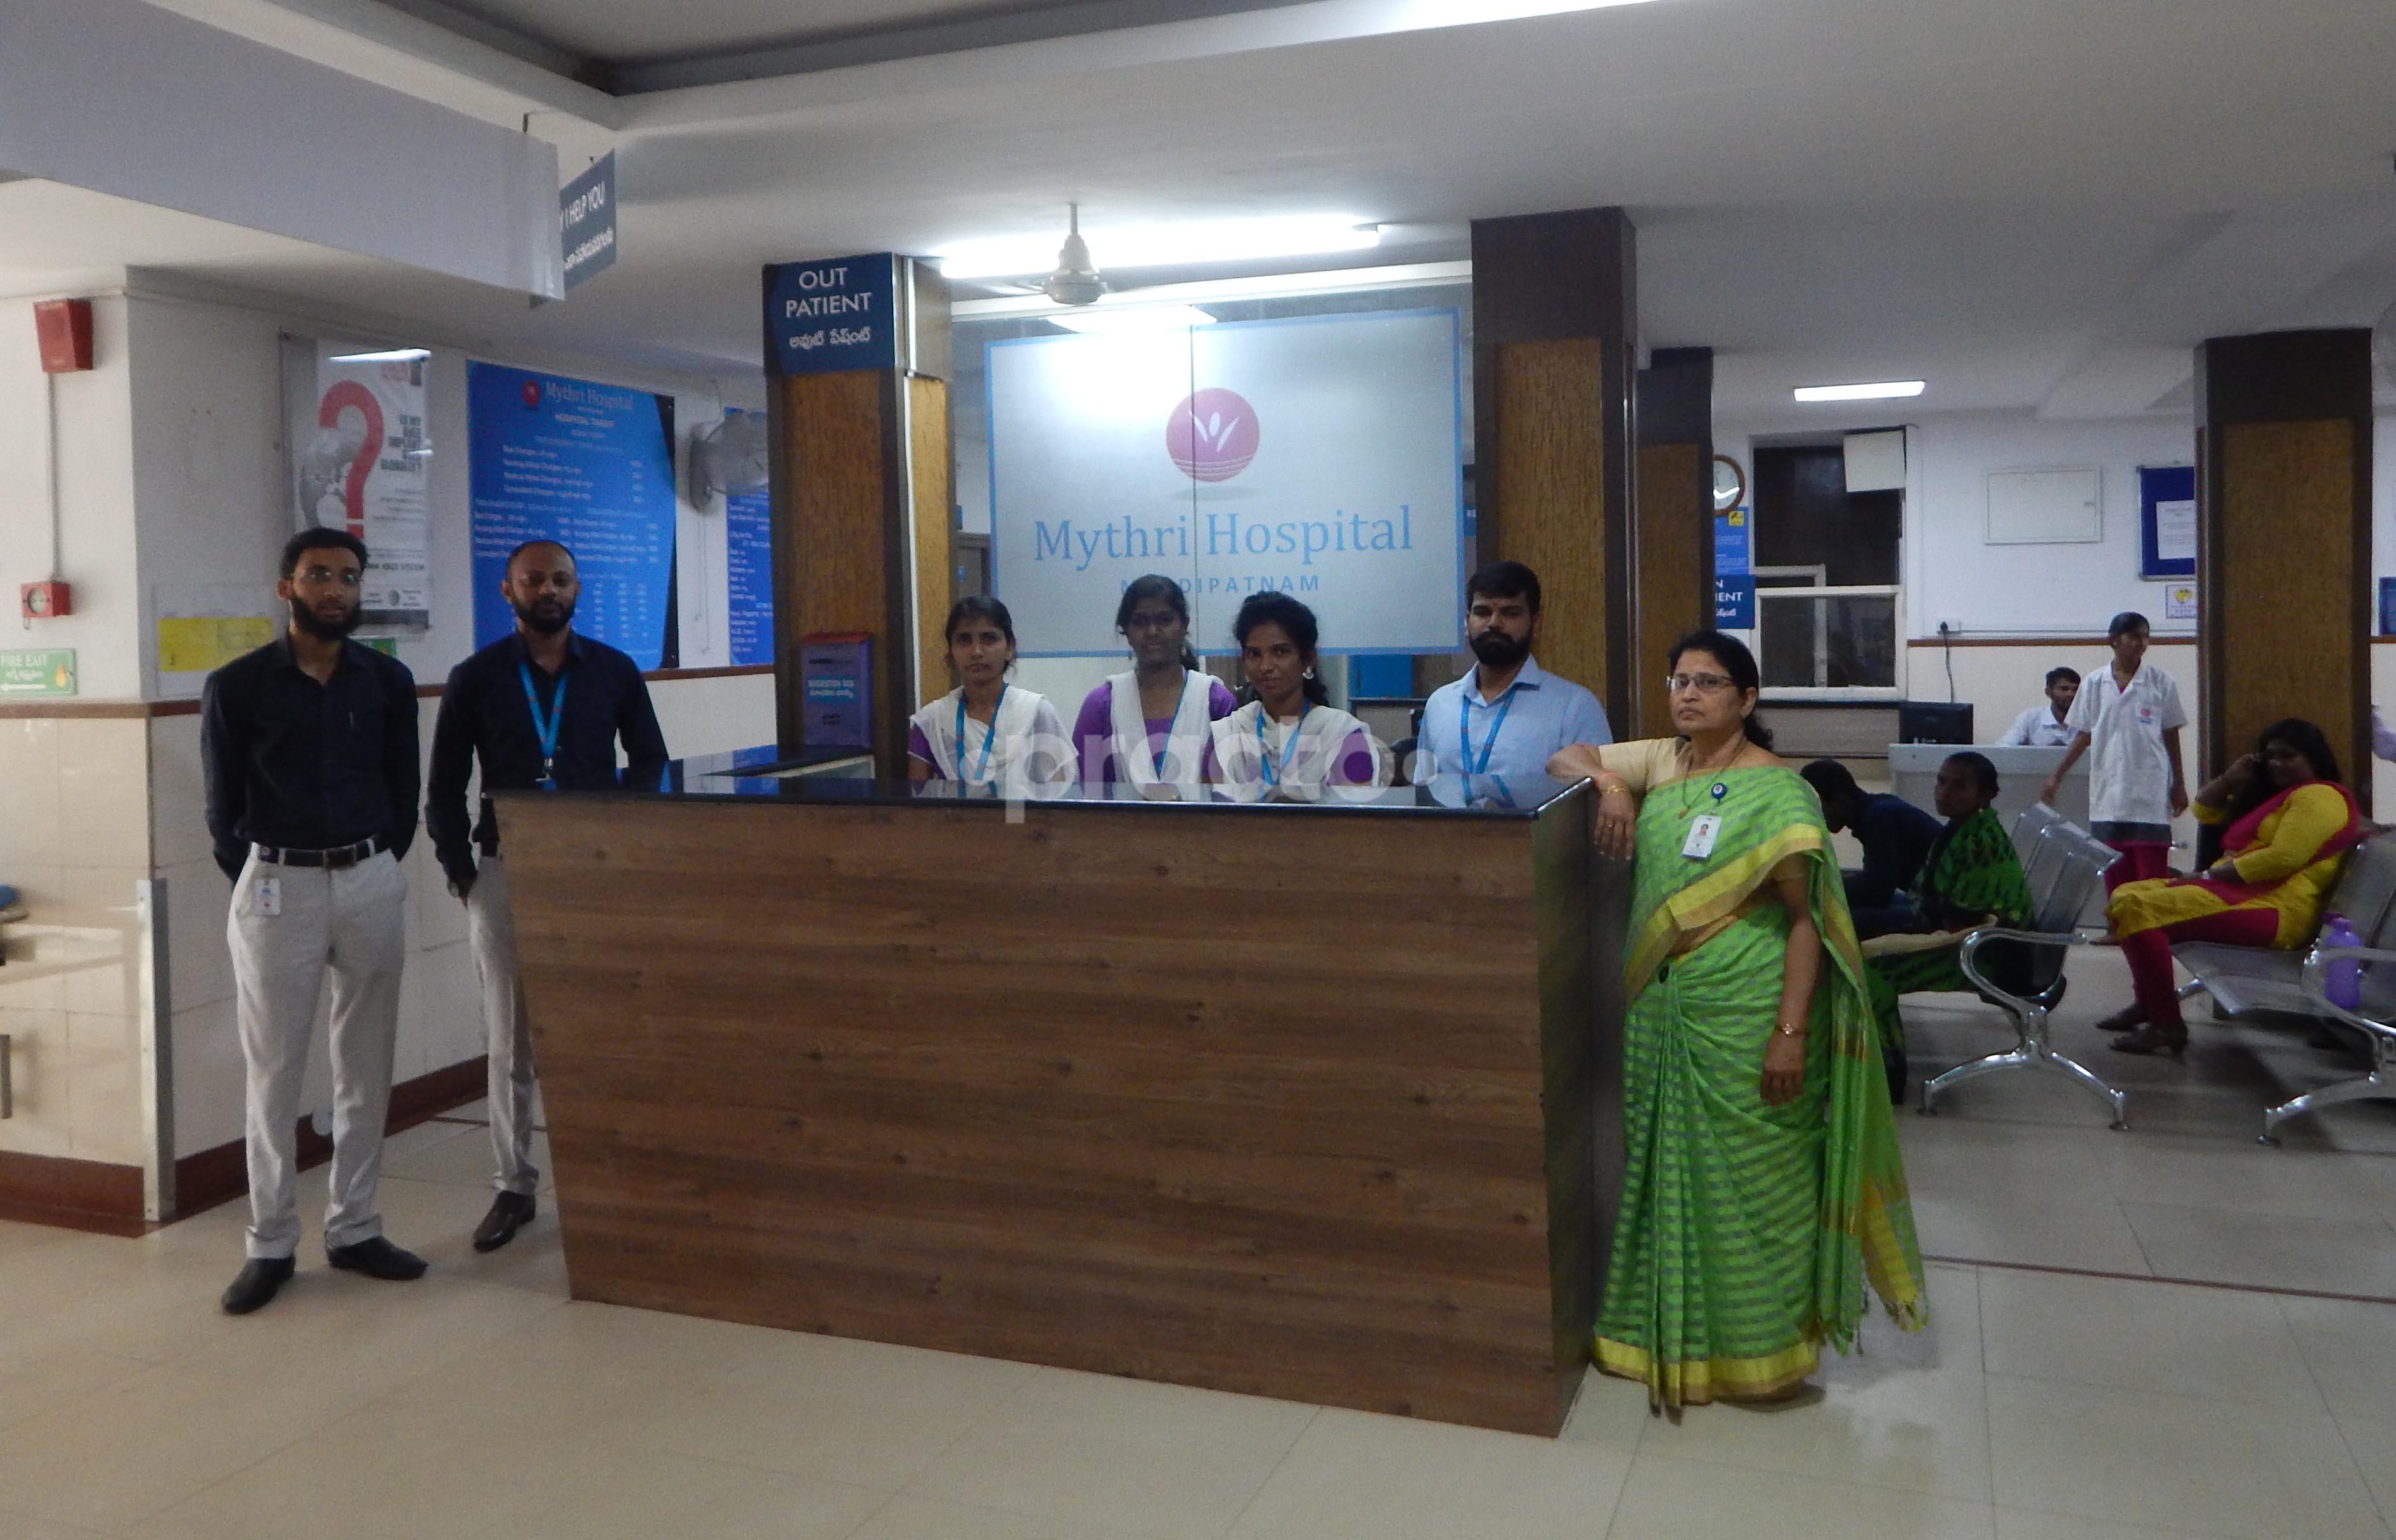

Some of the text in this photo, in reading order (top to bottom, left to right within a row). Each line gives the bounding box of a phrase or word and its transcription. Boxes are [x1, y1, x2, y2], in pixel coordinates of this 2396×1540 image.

[569, 194, 587, 225] HELP
[587, 180, 606, 212] YOU
[799, 267, 848, 290] OUT
[785, 292, 873, 318] PATIENT
[1034, 504, 1412, 571] Mythri Hospital
